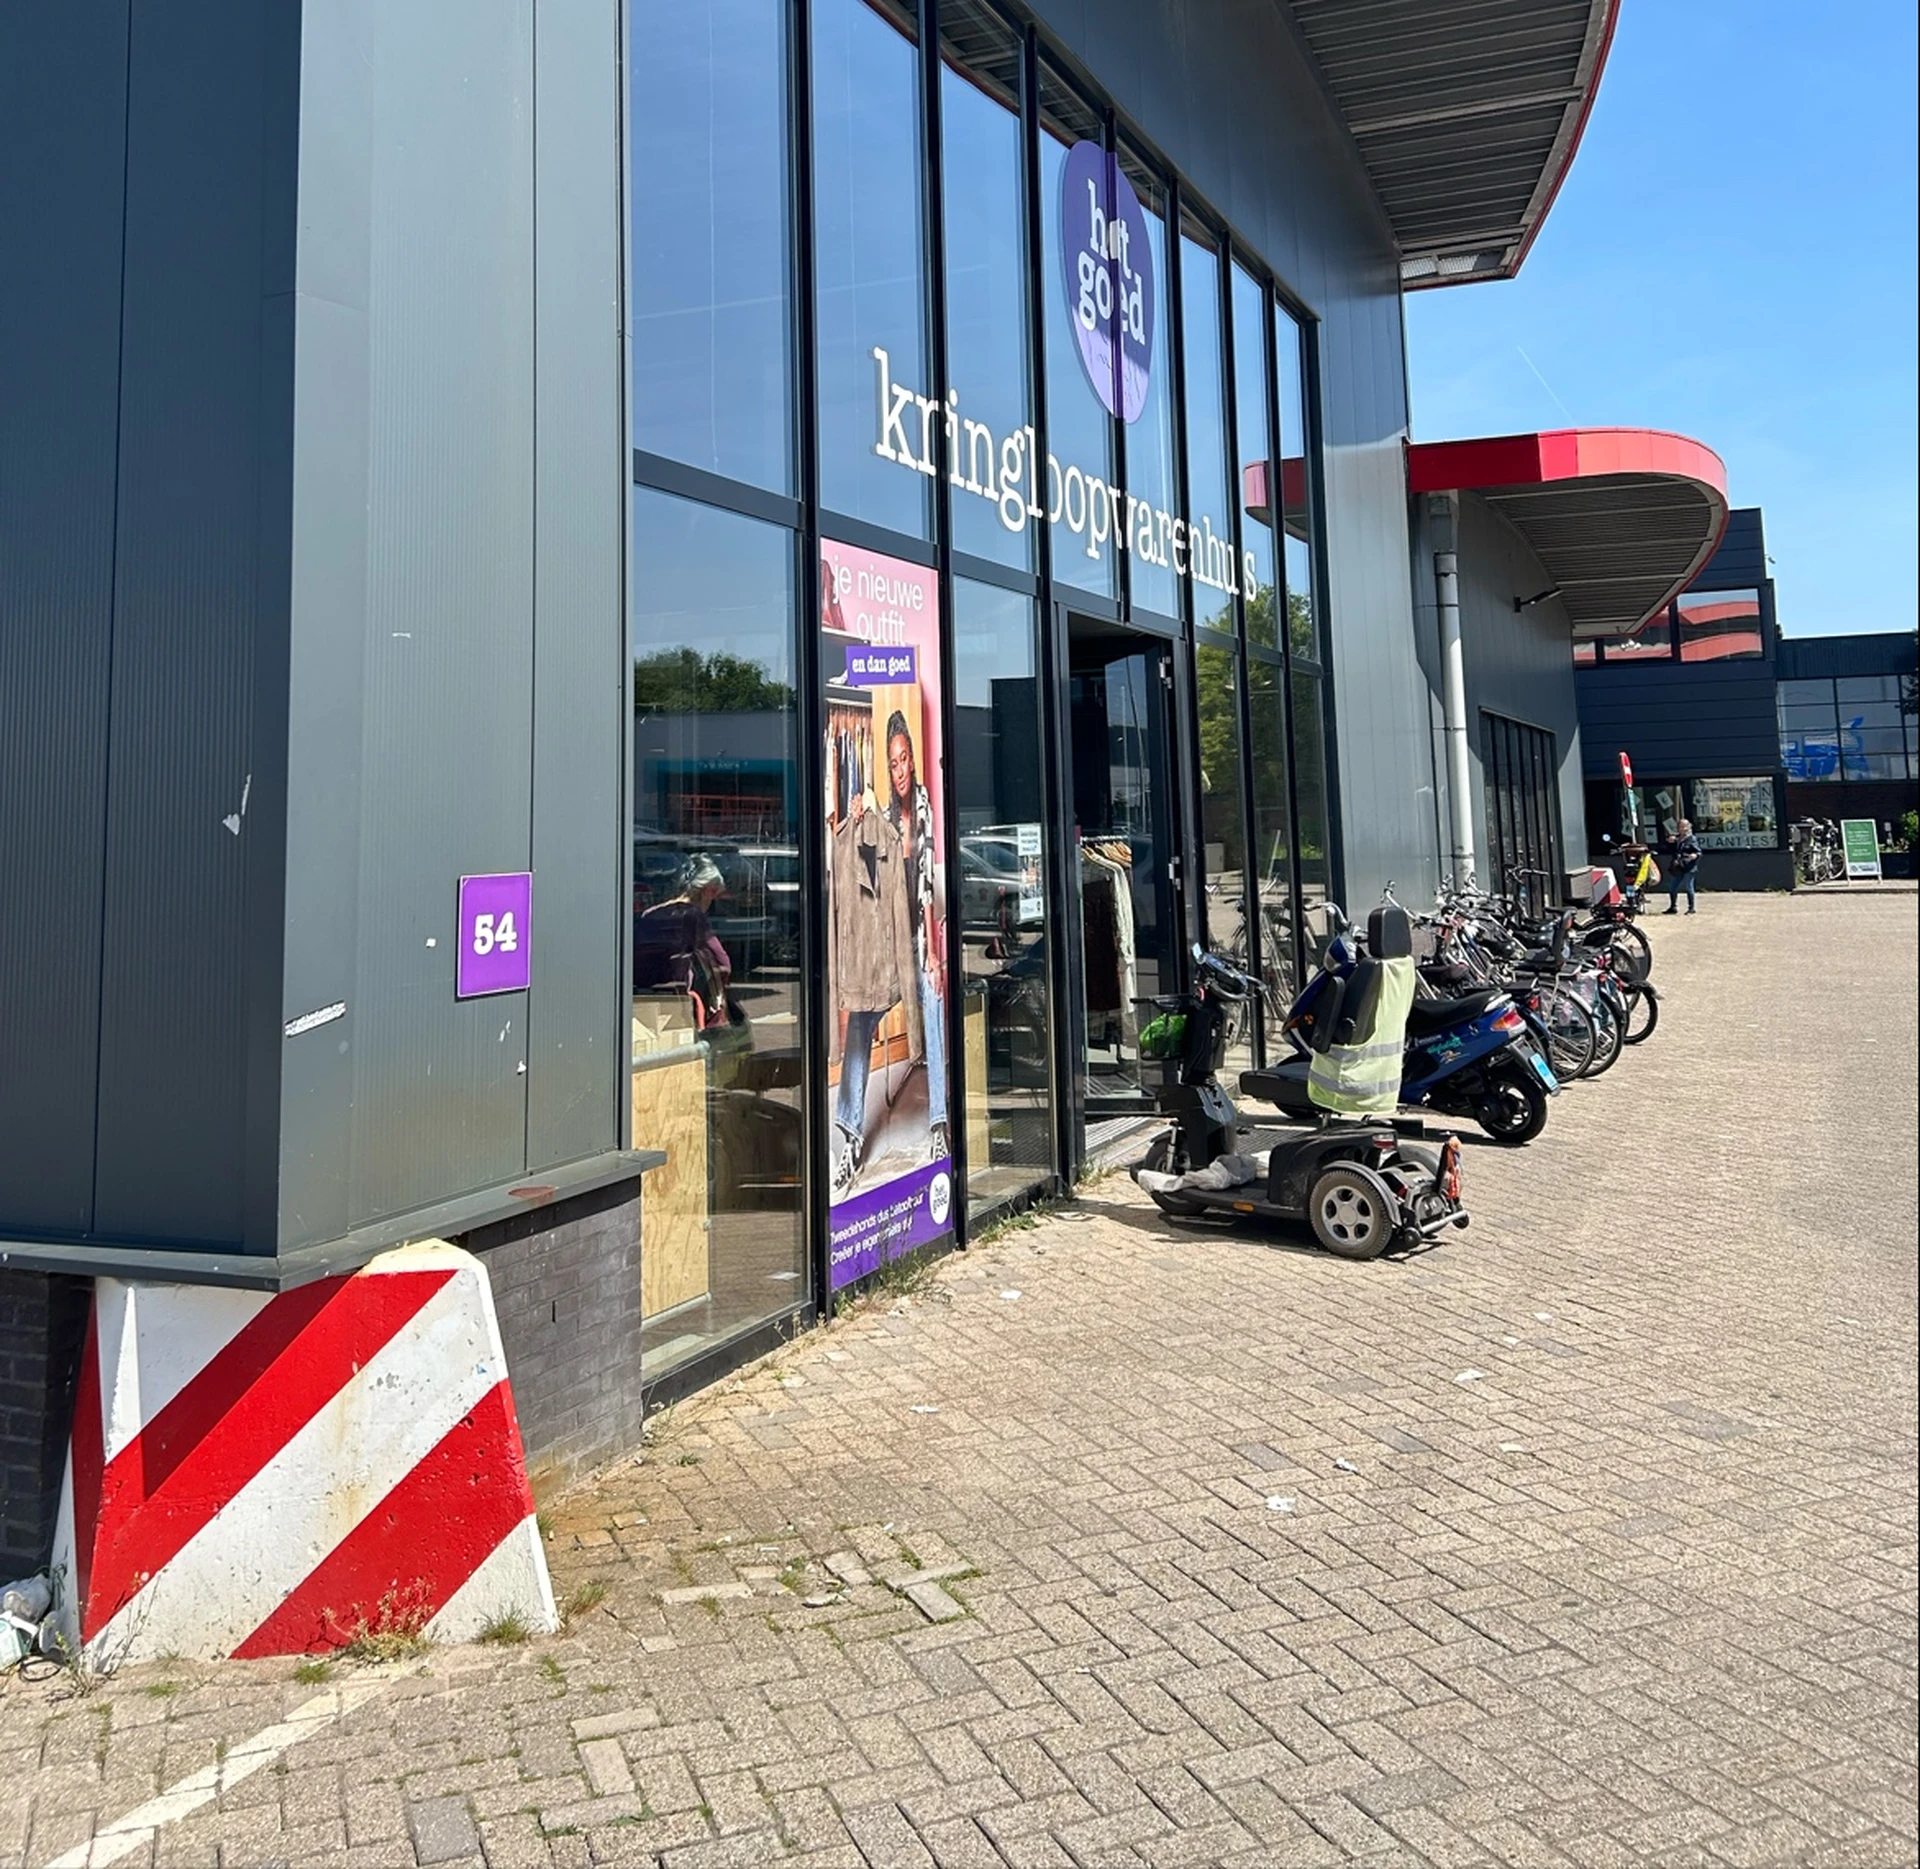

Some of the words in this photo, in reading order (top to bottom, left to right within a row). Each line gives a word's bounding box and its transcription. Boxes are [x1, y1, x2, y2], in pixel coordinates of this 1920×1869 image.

[1078, 251, 1146, 346] goed
[873, 346, 1257, 603] kringloopwarenhus
[832, 554, 852, 604] je
[858, 564, 924, 611] nieuwe
[856, 609, 906, 647] outfit
[852, 658, 866, 673] en
[867, 655, 887, 673] dan
[888, 655, 911, 677] goed
[1726, 820, 1748, 832] DE
[473, 911, 518, 955] 54
